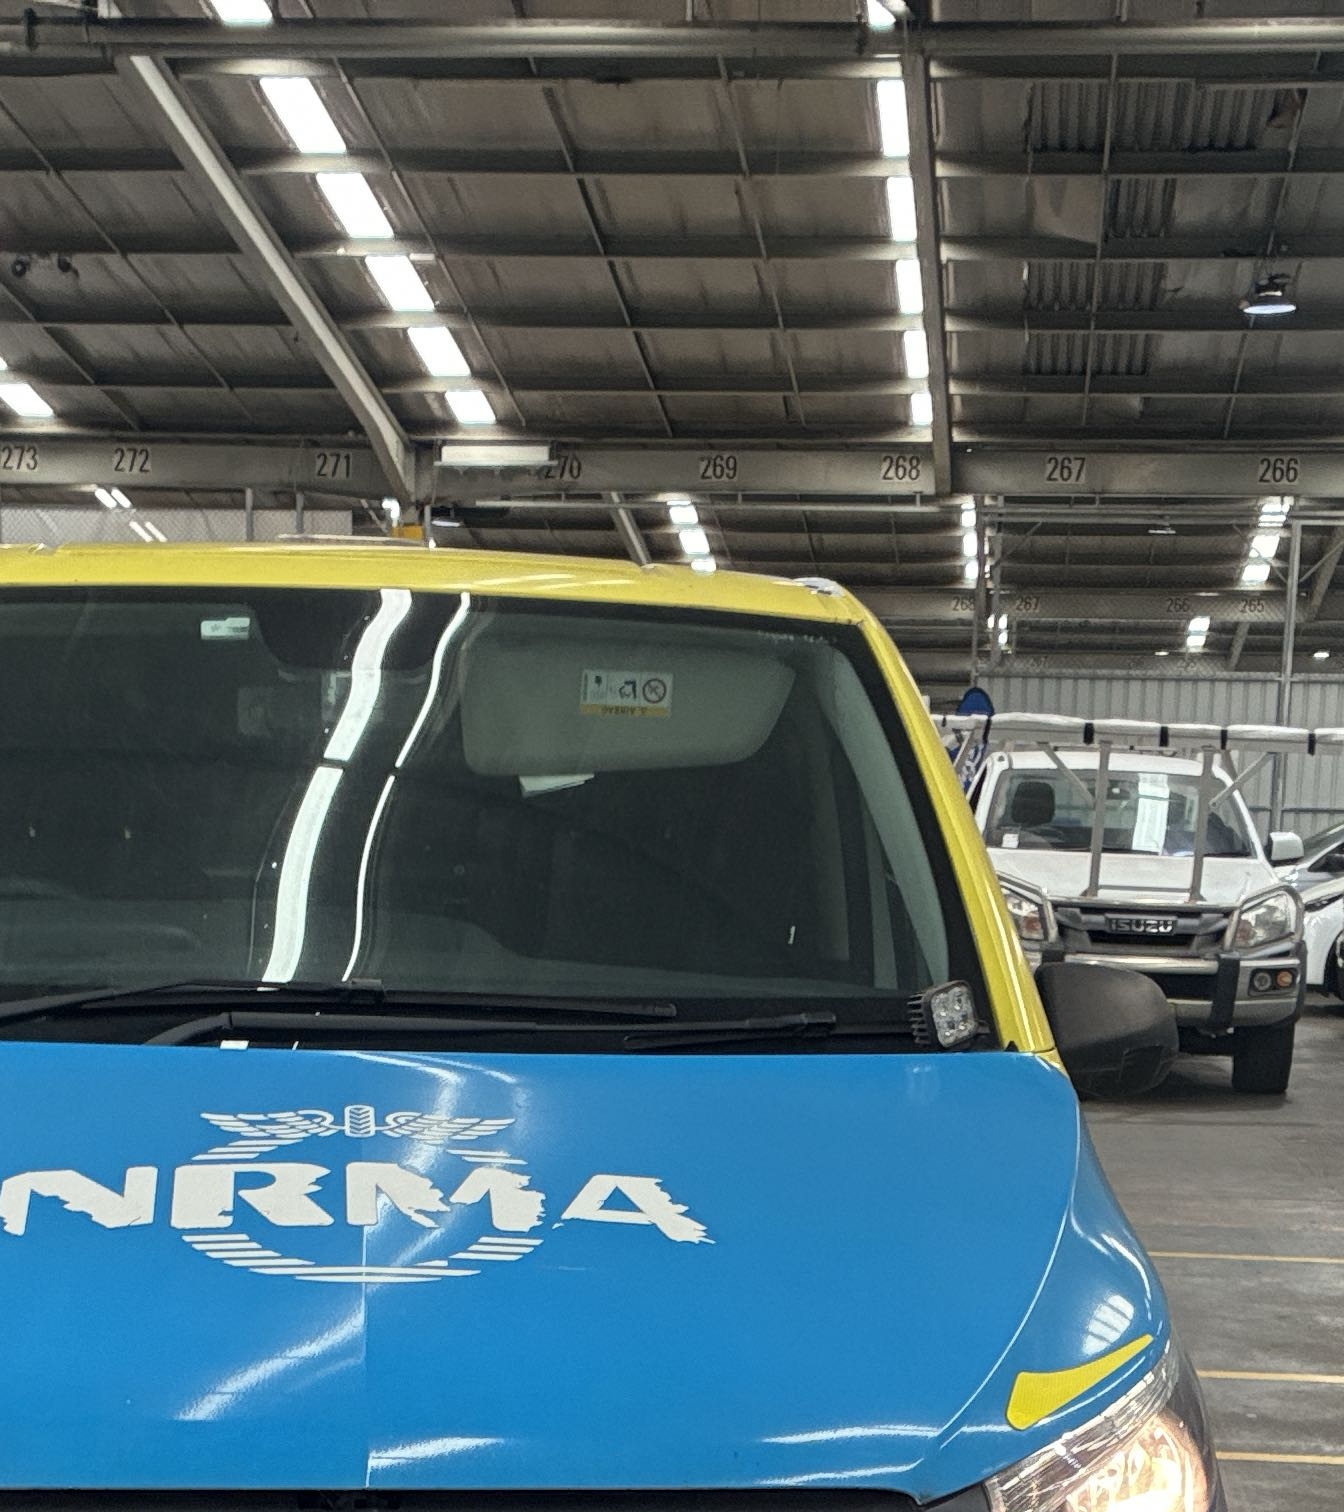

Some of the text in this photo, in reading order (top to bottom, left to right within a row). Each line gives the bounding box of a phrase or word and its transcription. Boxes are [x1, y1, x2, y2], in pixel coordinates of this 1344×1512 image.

[2, 446, 38, 471] 273
[114, 447, 150, 472] 272
[317, 452, 350, 478] 271
[700, 456, 737, 480] 269
[882, 456, 920, 481] 268
[1046, 457, 1086, 482] 267
[1258, 457, 1299, 483] 266
[1016, 596, 1039, 611] 267
[1166, 597, 1191, 613] 266
[1240, 599, 1266, 614] 265
[1111, 919, 1173, 933] ISUZU
